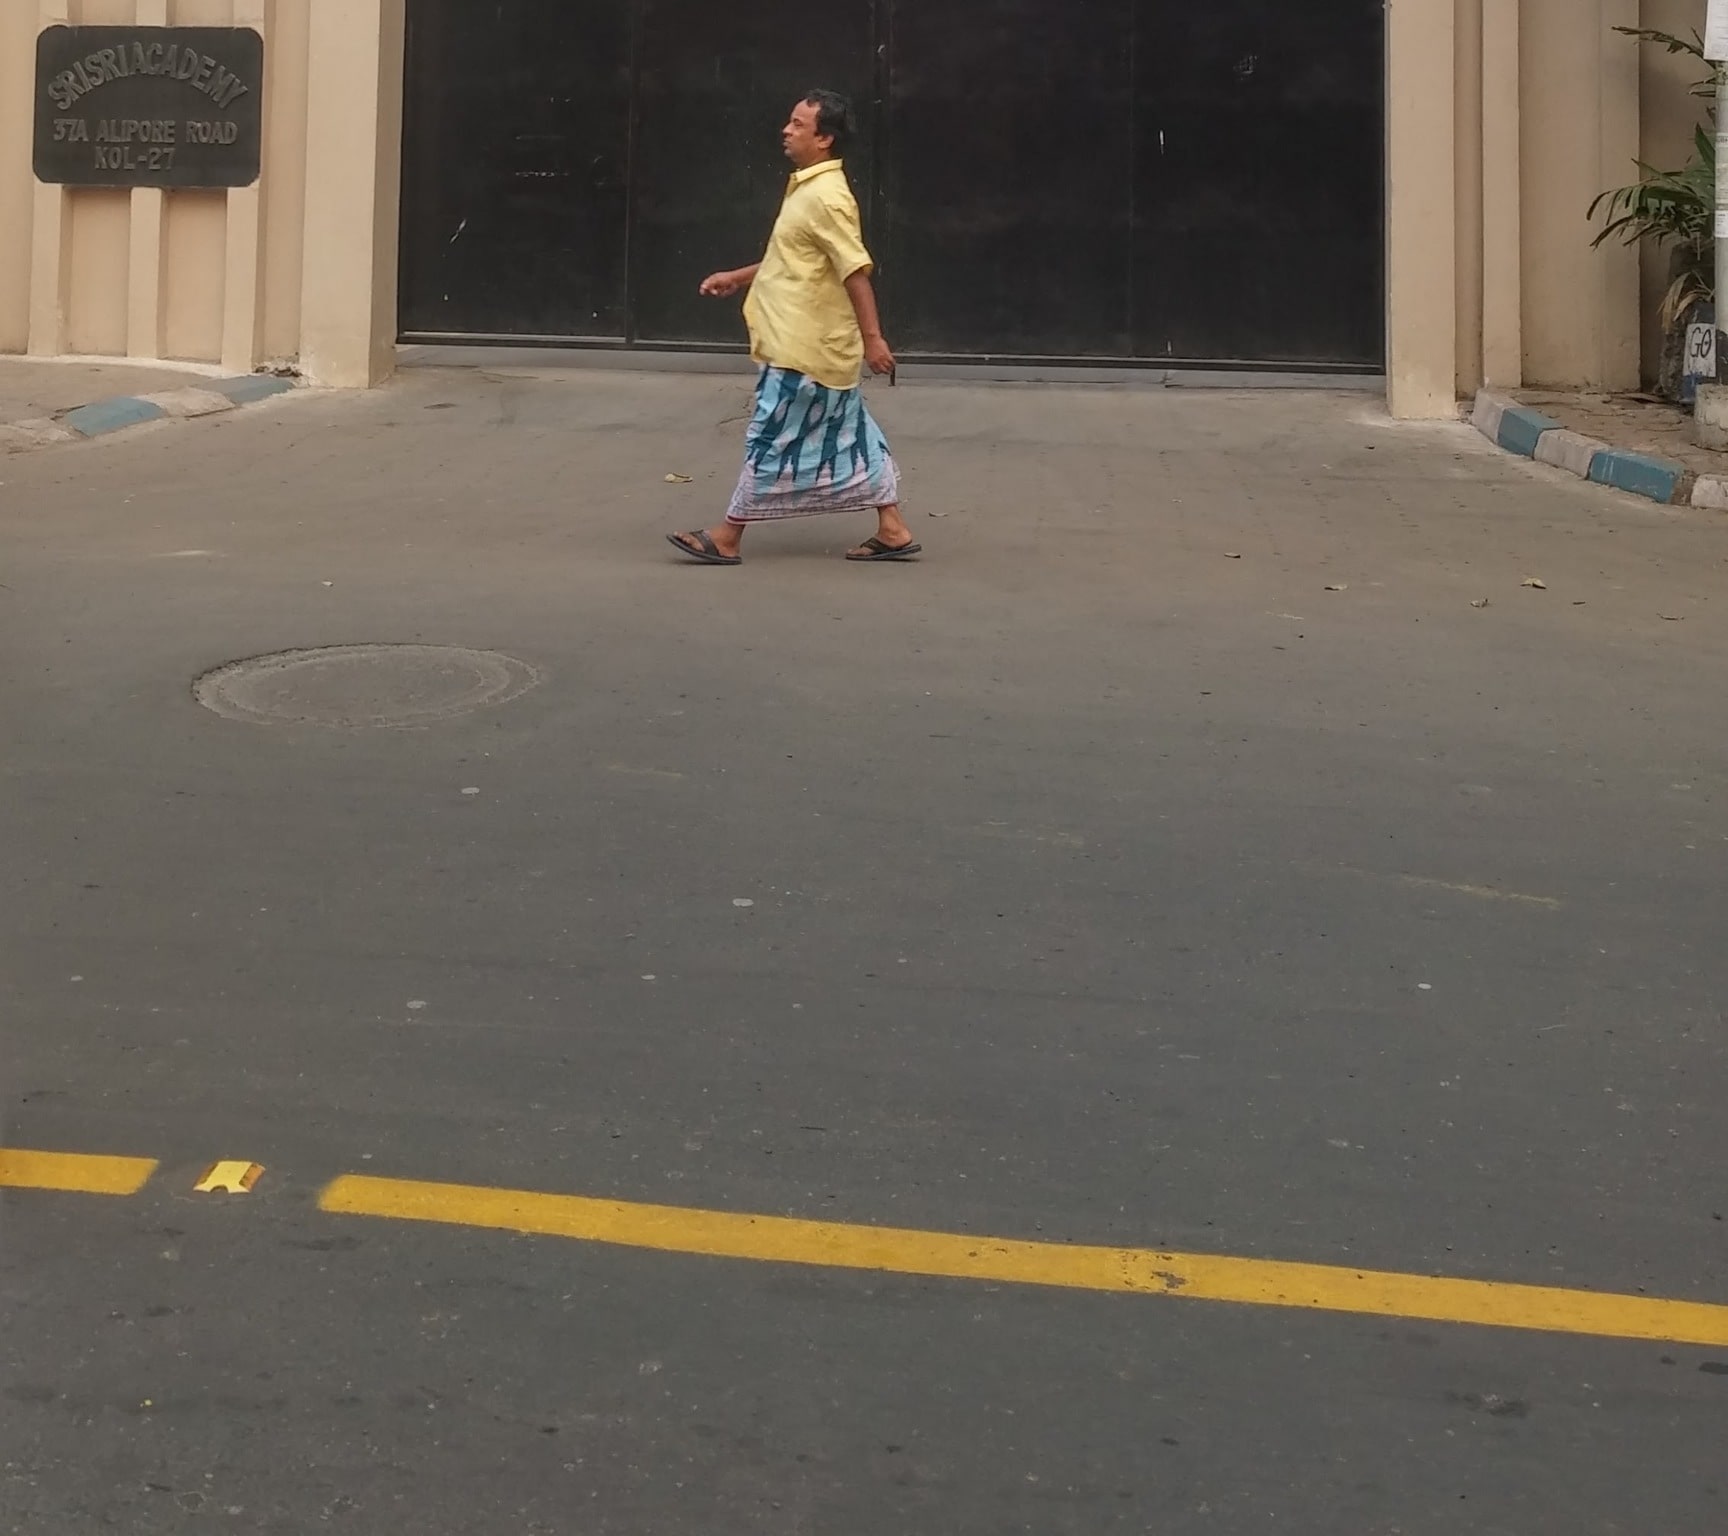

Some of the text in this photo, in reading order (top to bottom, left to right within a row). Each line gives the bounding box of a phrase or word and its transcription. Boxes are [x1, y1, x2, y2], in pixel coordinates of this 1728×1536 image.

[53, 118, 239, 145] 37A ALIPORE ROAD
[94, 146, 176, 171] KOL-27
